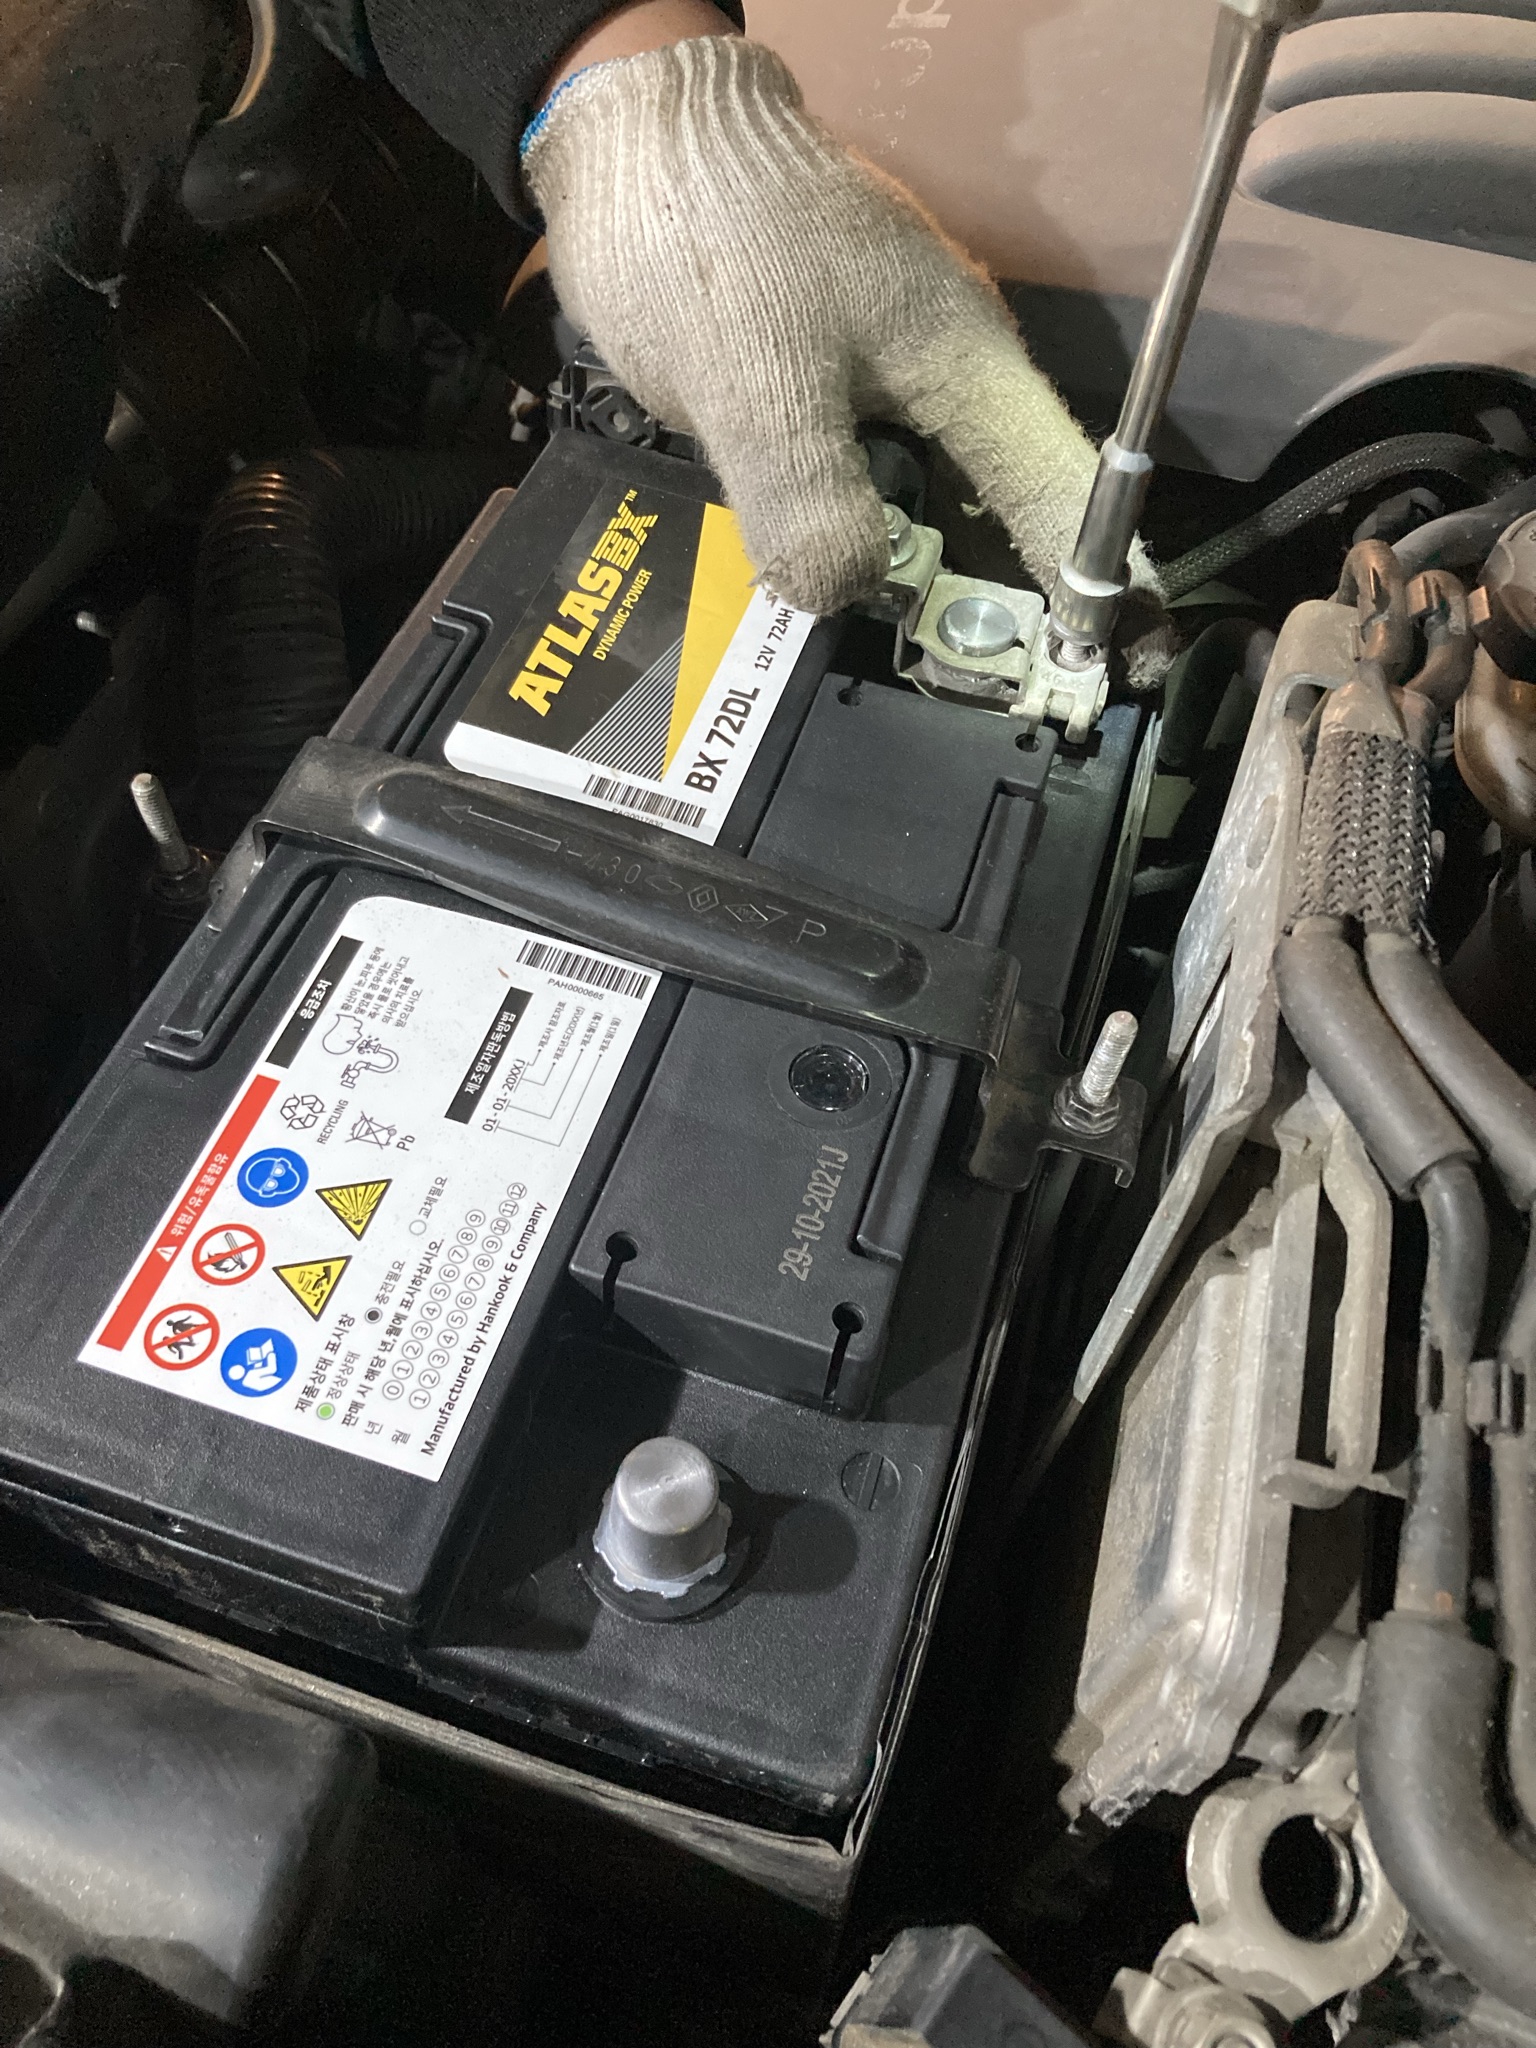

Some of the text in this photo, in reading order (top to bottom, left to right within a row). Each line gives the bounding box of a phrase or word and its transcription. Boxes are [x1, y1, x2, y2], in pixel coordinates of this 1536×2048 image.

[592, 568, 653, 661] DYNAMIC POWER
[684, 608, 795, 794] BX 72DL 12V 72AH
[300, 979, 332, 1020] 응급조치
[547, 978, 605, 1001] PAH0000665
[464, 1010, 516, 1096] 제조일자판독방법
[316, 1099, 349, 1144] RECYCLING
[396, 1133, 416, 1152] Pb
[418, 1176, 448, 1219] 교체필요
[778, 1144, 849, 1282] 29-10-2021J
[375, 1261, 406, 1305] 충전필요
[420, 1202, 548, 1456] Manufactured by Hankook & Company
[295, 1313, 356, 1412] 제품상태 표시창
[326, 1351, 361, 1400] 정상상태
[364, 1355, 387, 1381] 해당
[356, 1384, 373, 1398] 시
[341, 1400, 366, 1427] 판매
[365, 1420, 383, 1435] 년
[391, 1430, 411, 1445] 월
